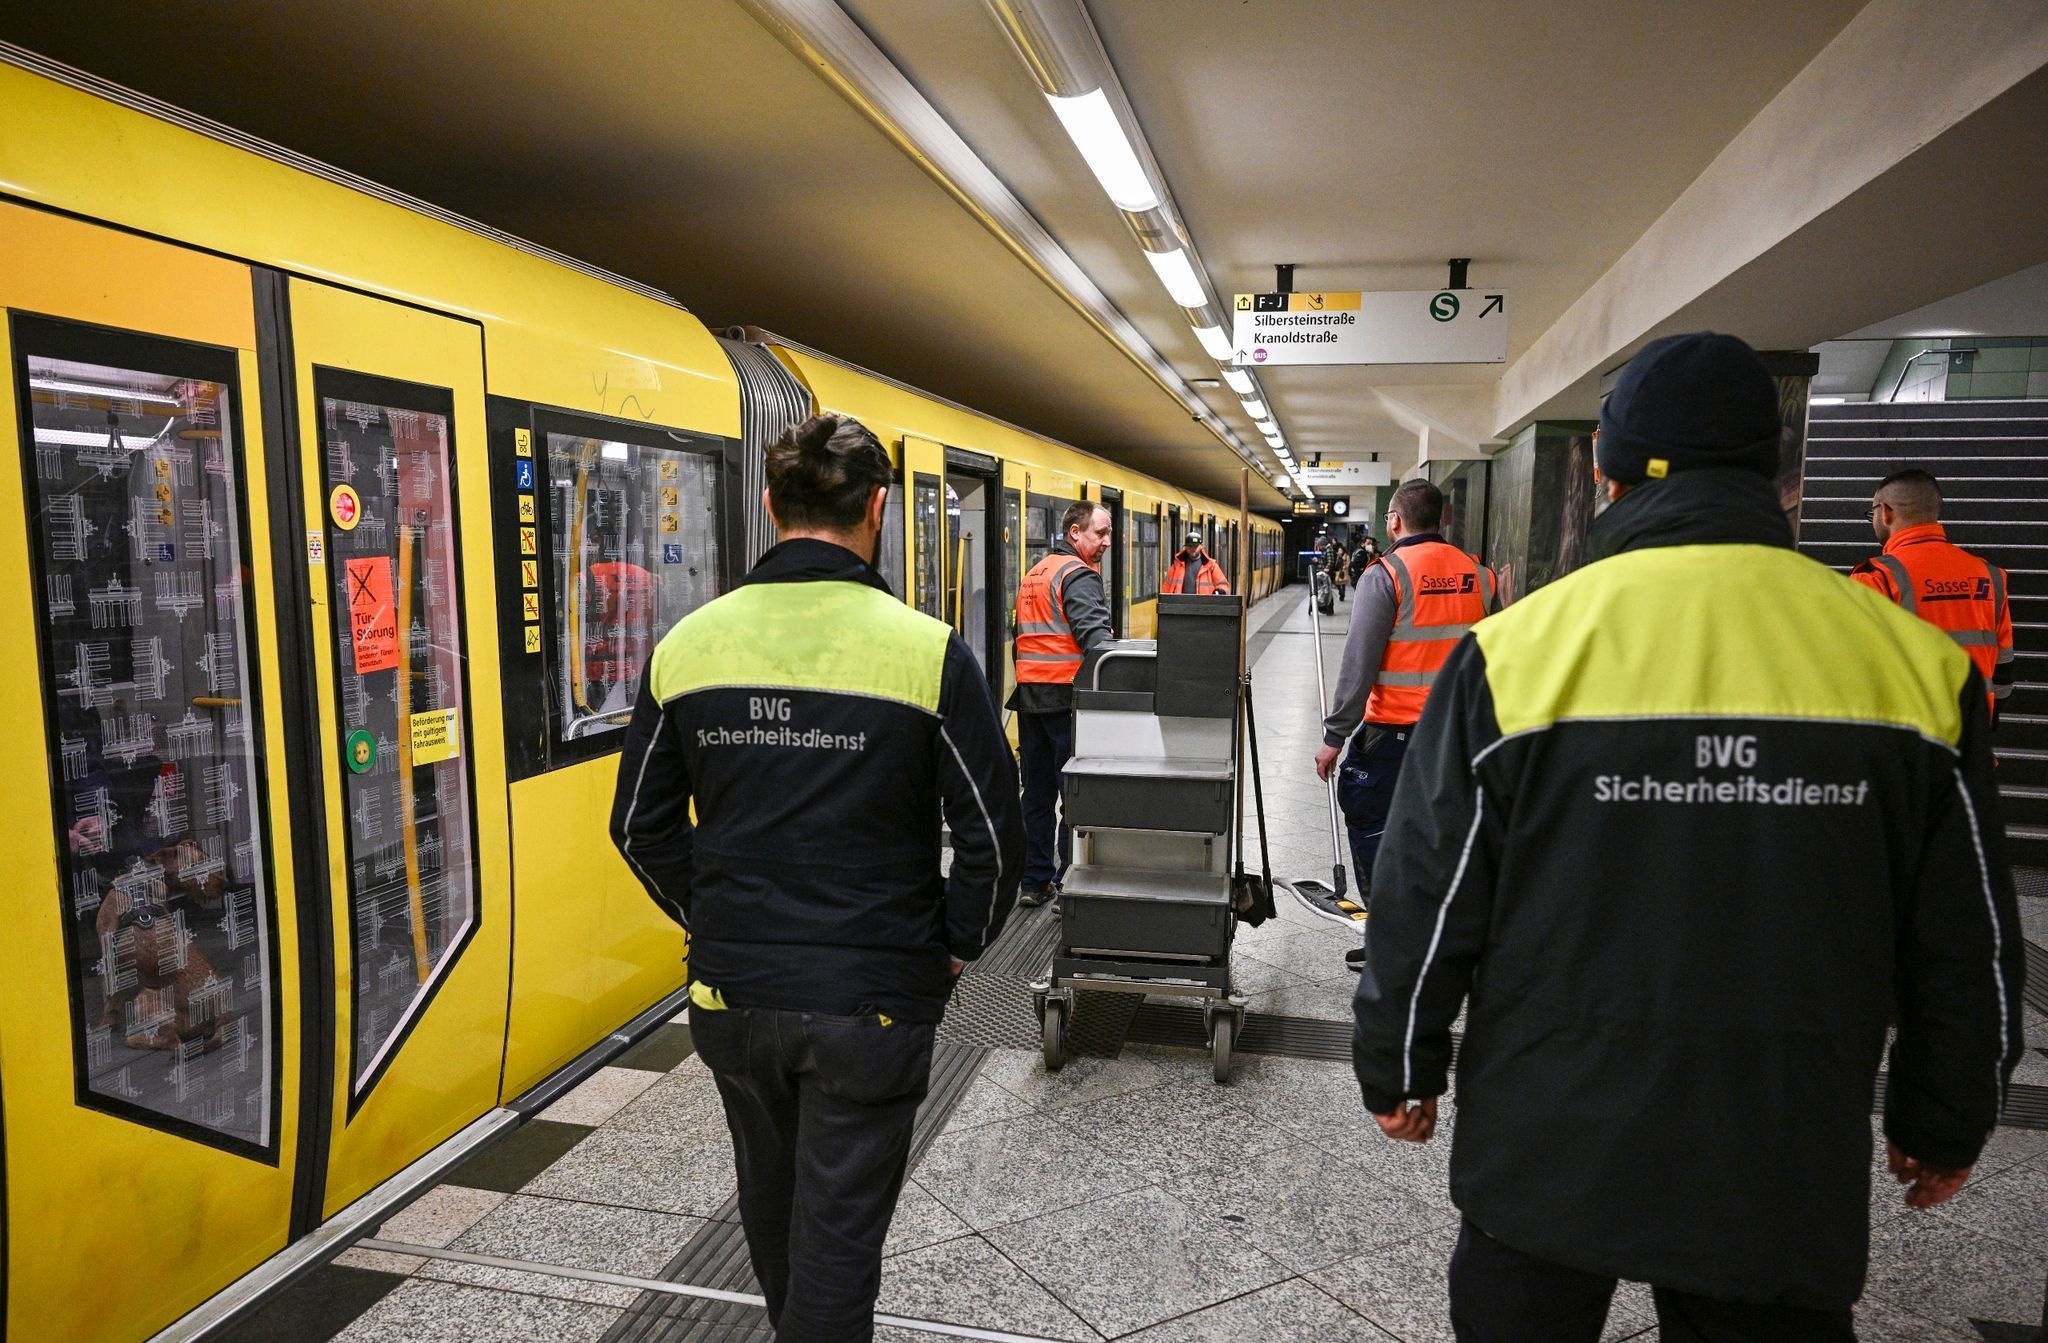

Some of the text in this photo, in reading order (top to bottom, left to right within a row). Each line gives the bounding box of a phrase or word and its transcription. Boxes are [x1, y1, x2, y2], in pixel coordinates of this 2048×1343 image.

[1259, 296, 1266, 309] F
[1277, 296, 1283, 308] J
[1433, 294, 1457, 320] S
[1254, 312, 1355, 327] Silbersteinstraße
[1254, 330, 1338, 344] Kranoldstraße
[1421, 574, 1456, 589] Sasse
[1924, 578, 1969, 594] Sasse
[355, 612, 375, 625] Tür-
[749, 696, 792, 721] BVG
[412, 715, 445, 727] Beförderung
[412, 726, 447, 738] mit gültigem
[413, 736, 446, 749] Fahrausweis
[1695, 734, 1758, 768] BVG
[1594, 774, 1869, 806] Sicherheitsdienst
